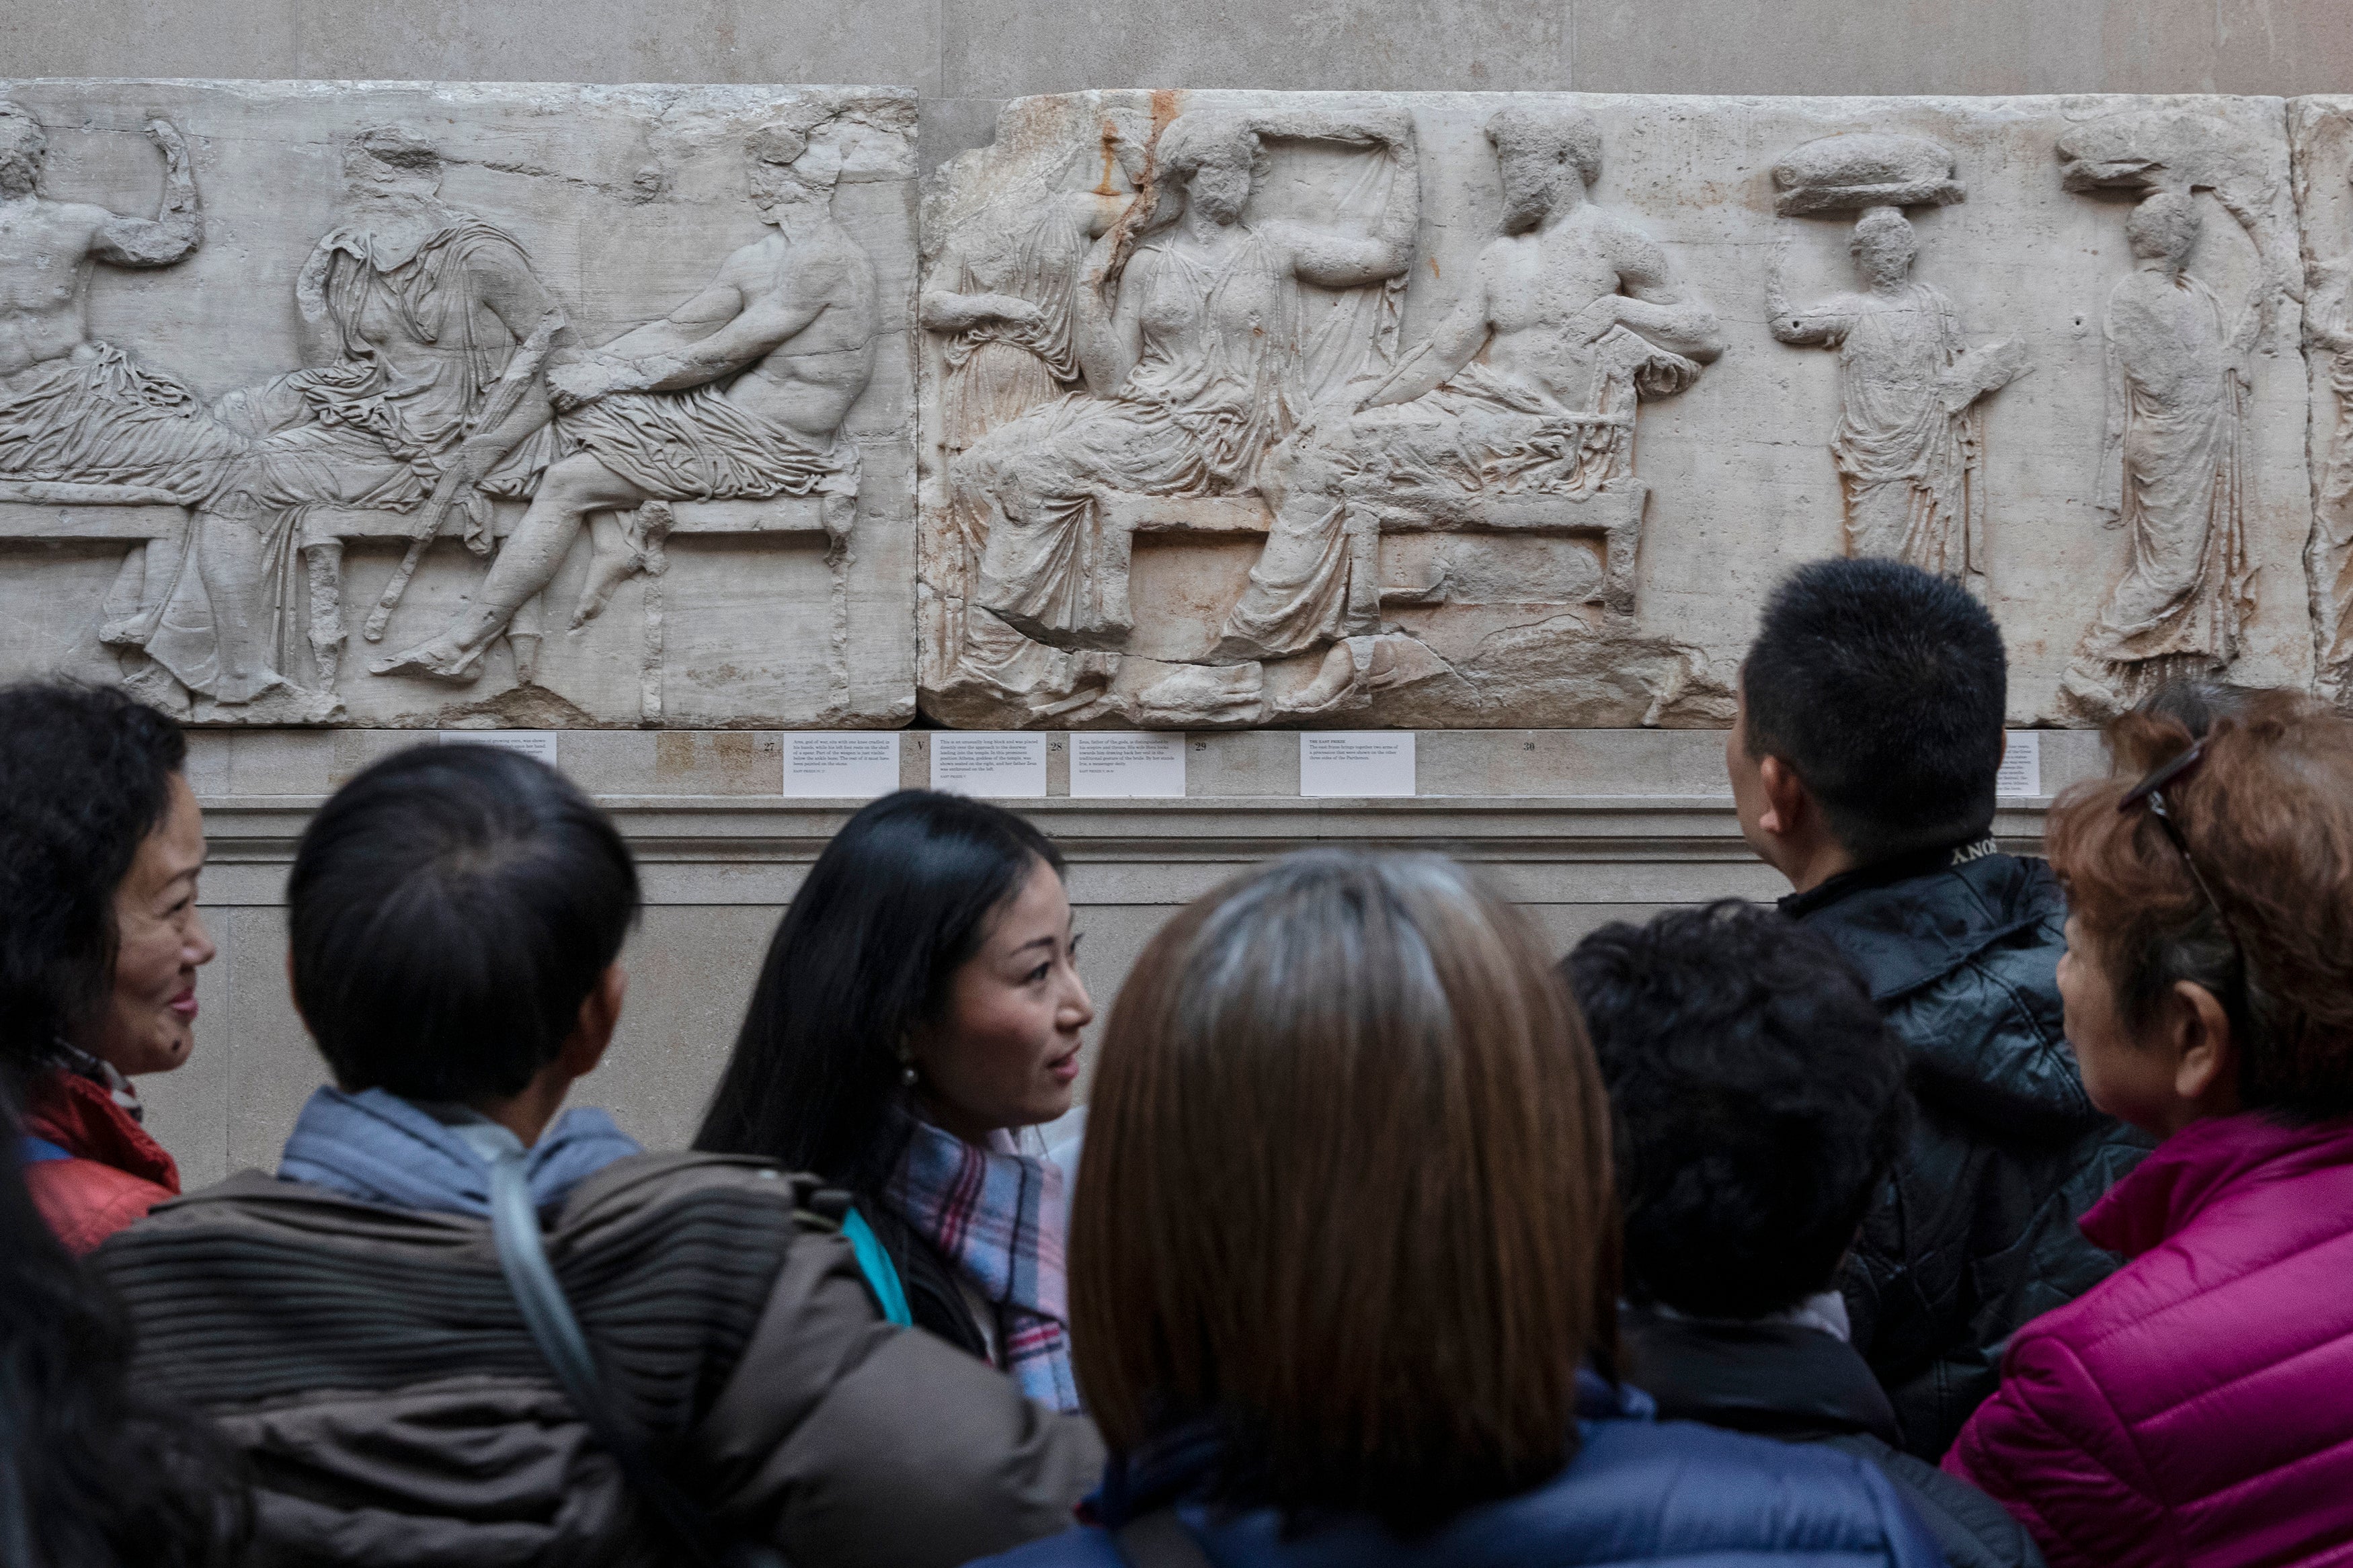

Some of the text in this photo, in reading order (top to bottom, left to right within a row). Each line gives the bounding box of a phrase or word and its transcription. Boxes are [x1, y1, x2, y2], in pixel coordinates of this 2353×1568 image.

[764, 742, 775, 751] 27
[917, 741, 925, 750] V
[1051, 742, 1062, 751] 28
[1195, 742, 1206, 751] 29
[1523, 742, 1535, 751] 30
